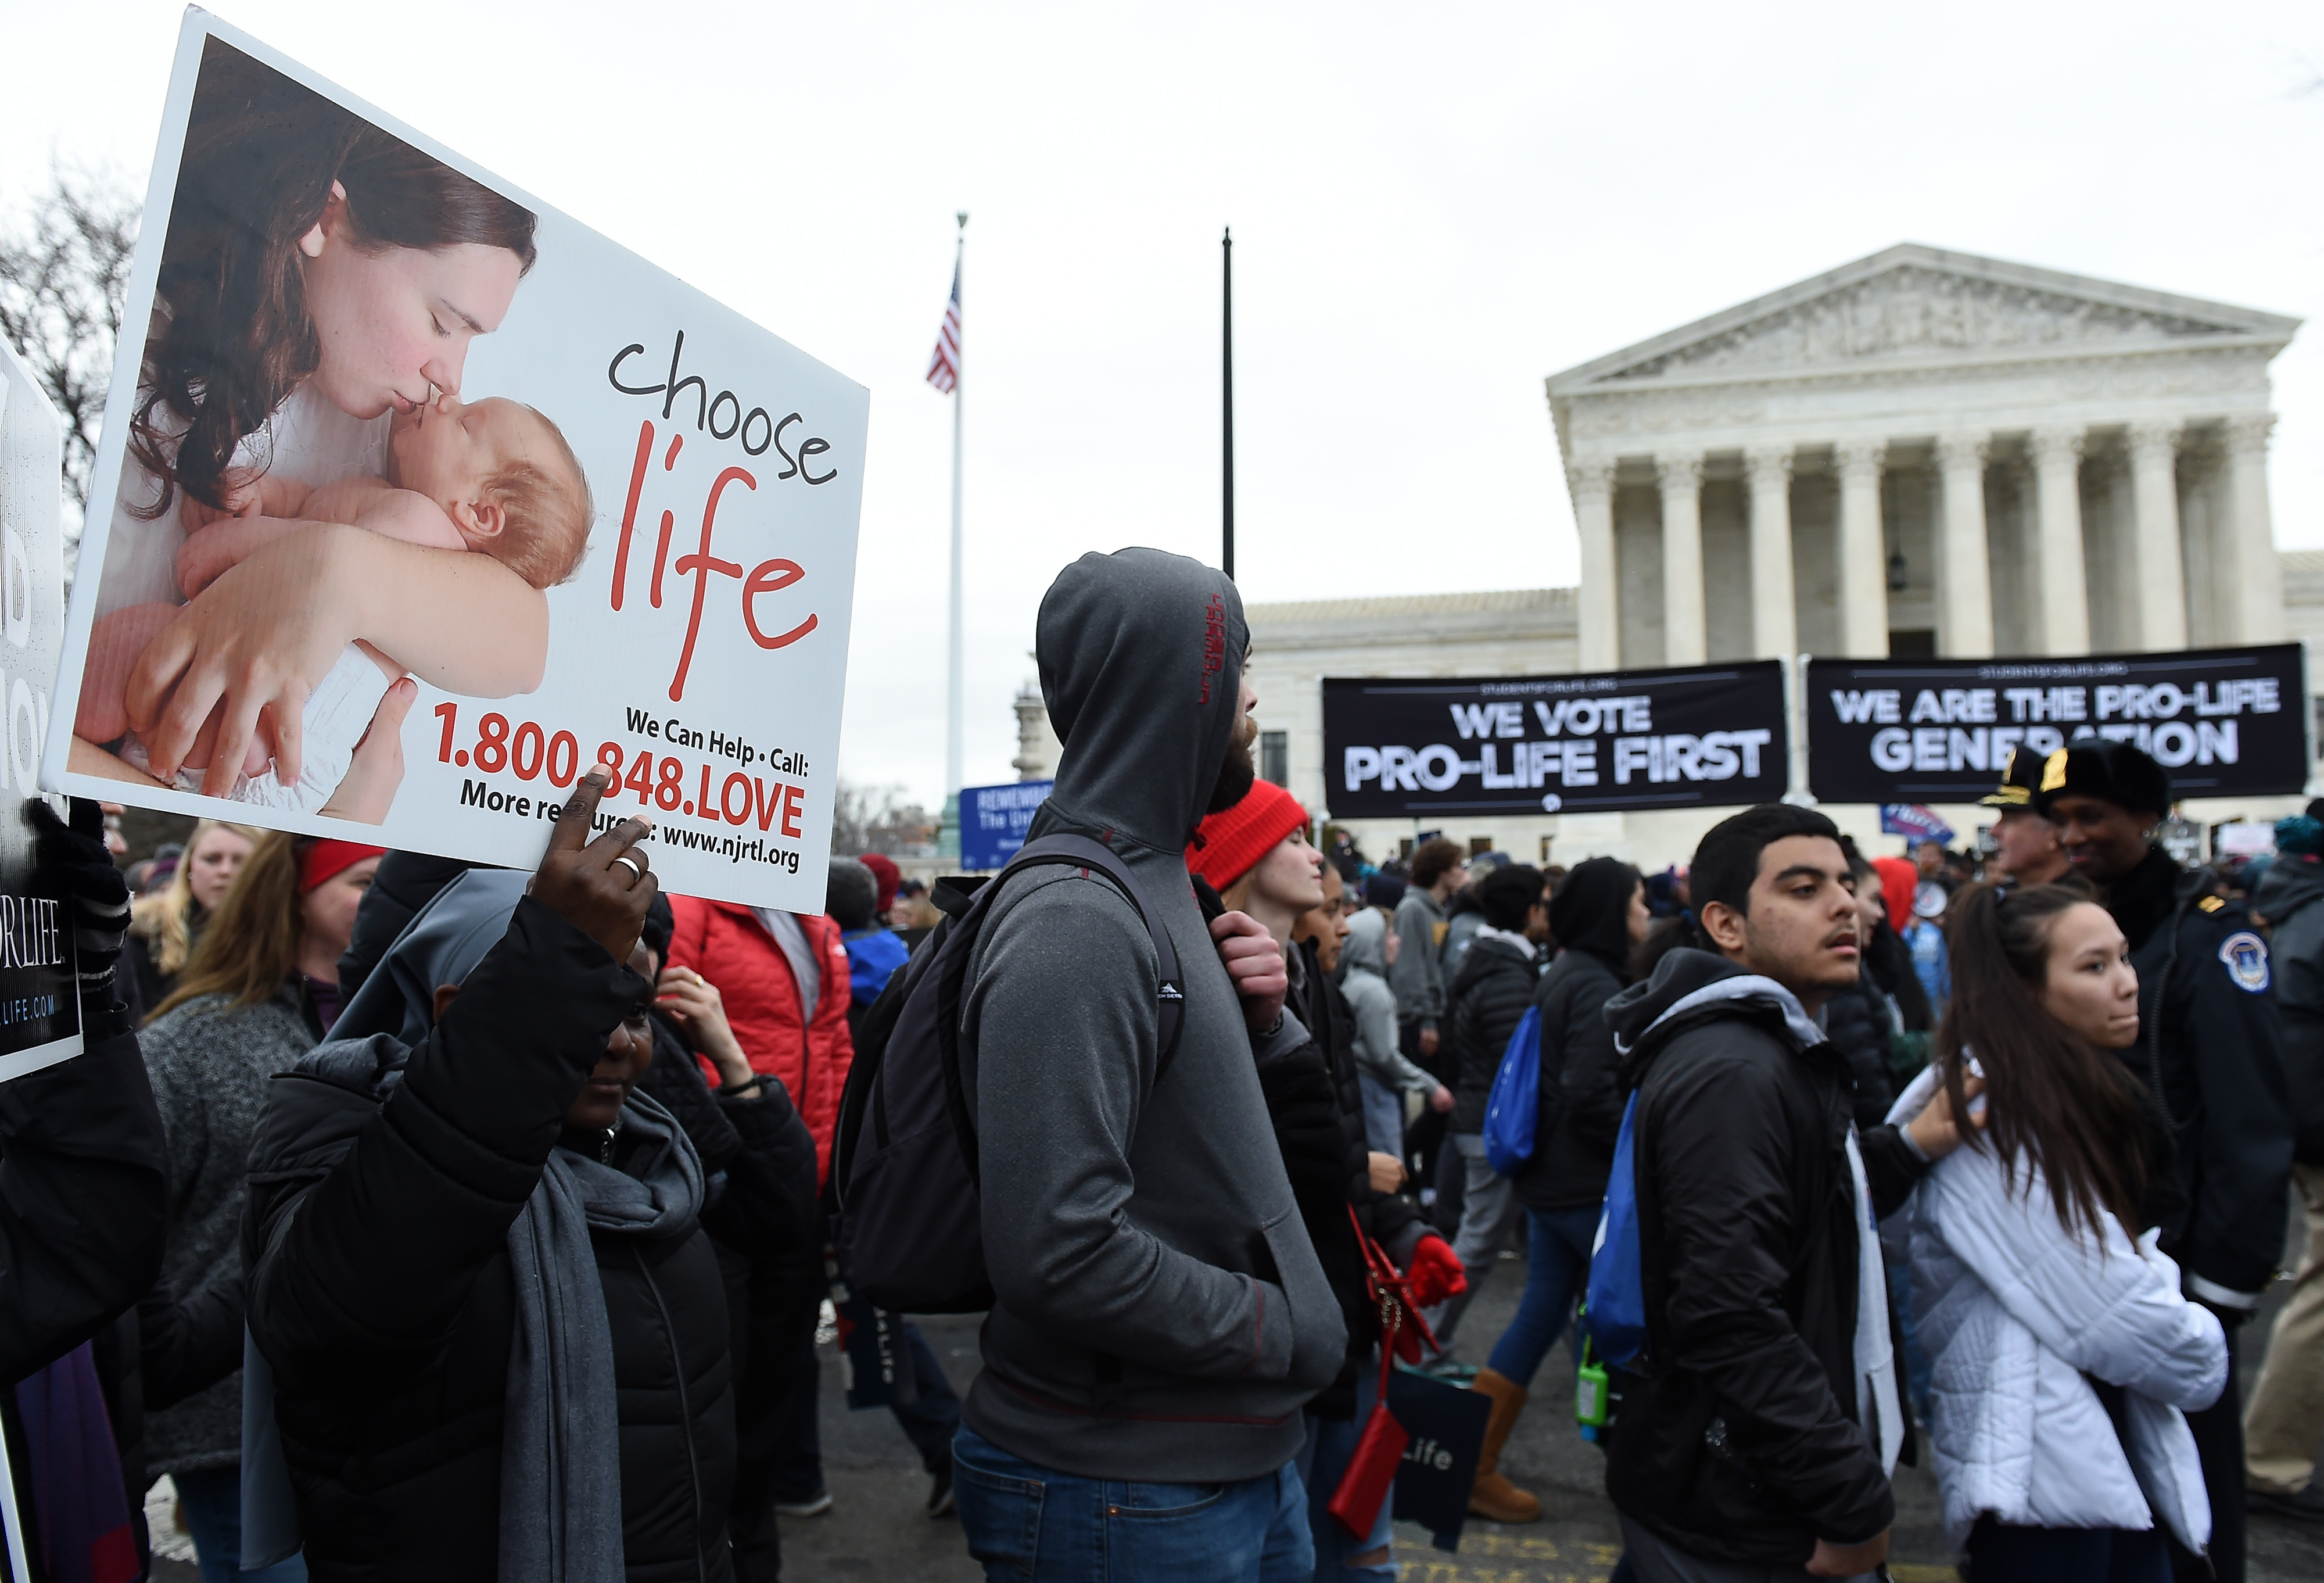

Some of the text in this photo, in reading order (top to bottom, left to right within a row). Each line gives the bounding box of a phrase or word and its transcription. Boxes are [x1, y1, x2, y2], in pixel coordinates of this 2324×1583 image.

[608, 330, 837, 485] choose
[611, 420, 818, 702] life
[1449, 695, 1653, 739] WE VOTE
[1830, 676, 2282, 724] WE ARE THE PRO-LIFE
[626, 707, 809, 778] We Can Help Call:
[1344, 728, 1772, 792] PRO-LIFE FIRST
[460, 779, 530, 817] More
[664, 826, 799, 874] www.njrtl.org
[0, 994, 55, 1026] LIFE.COM
